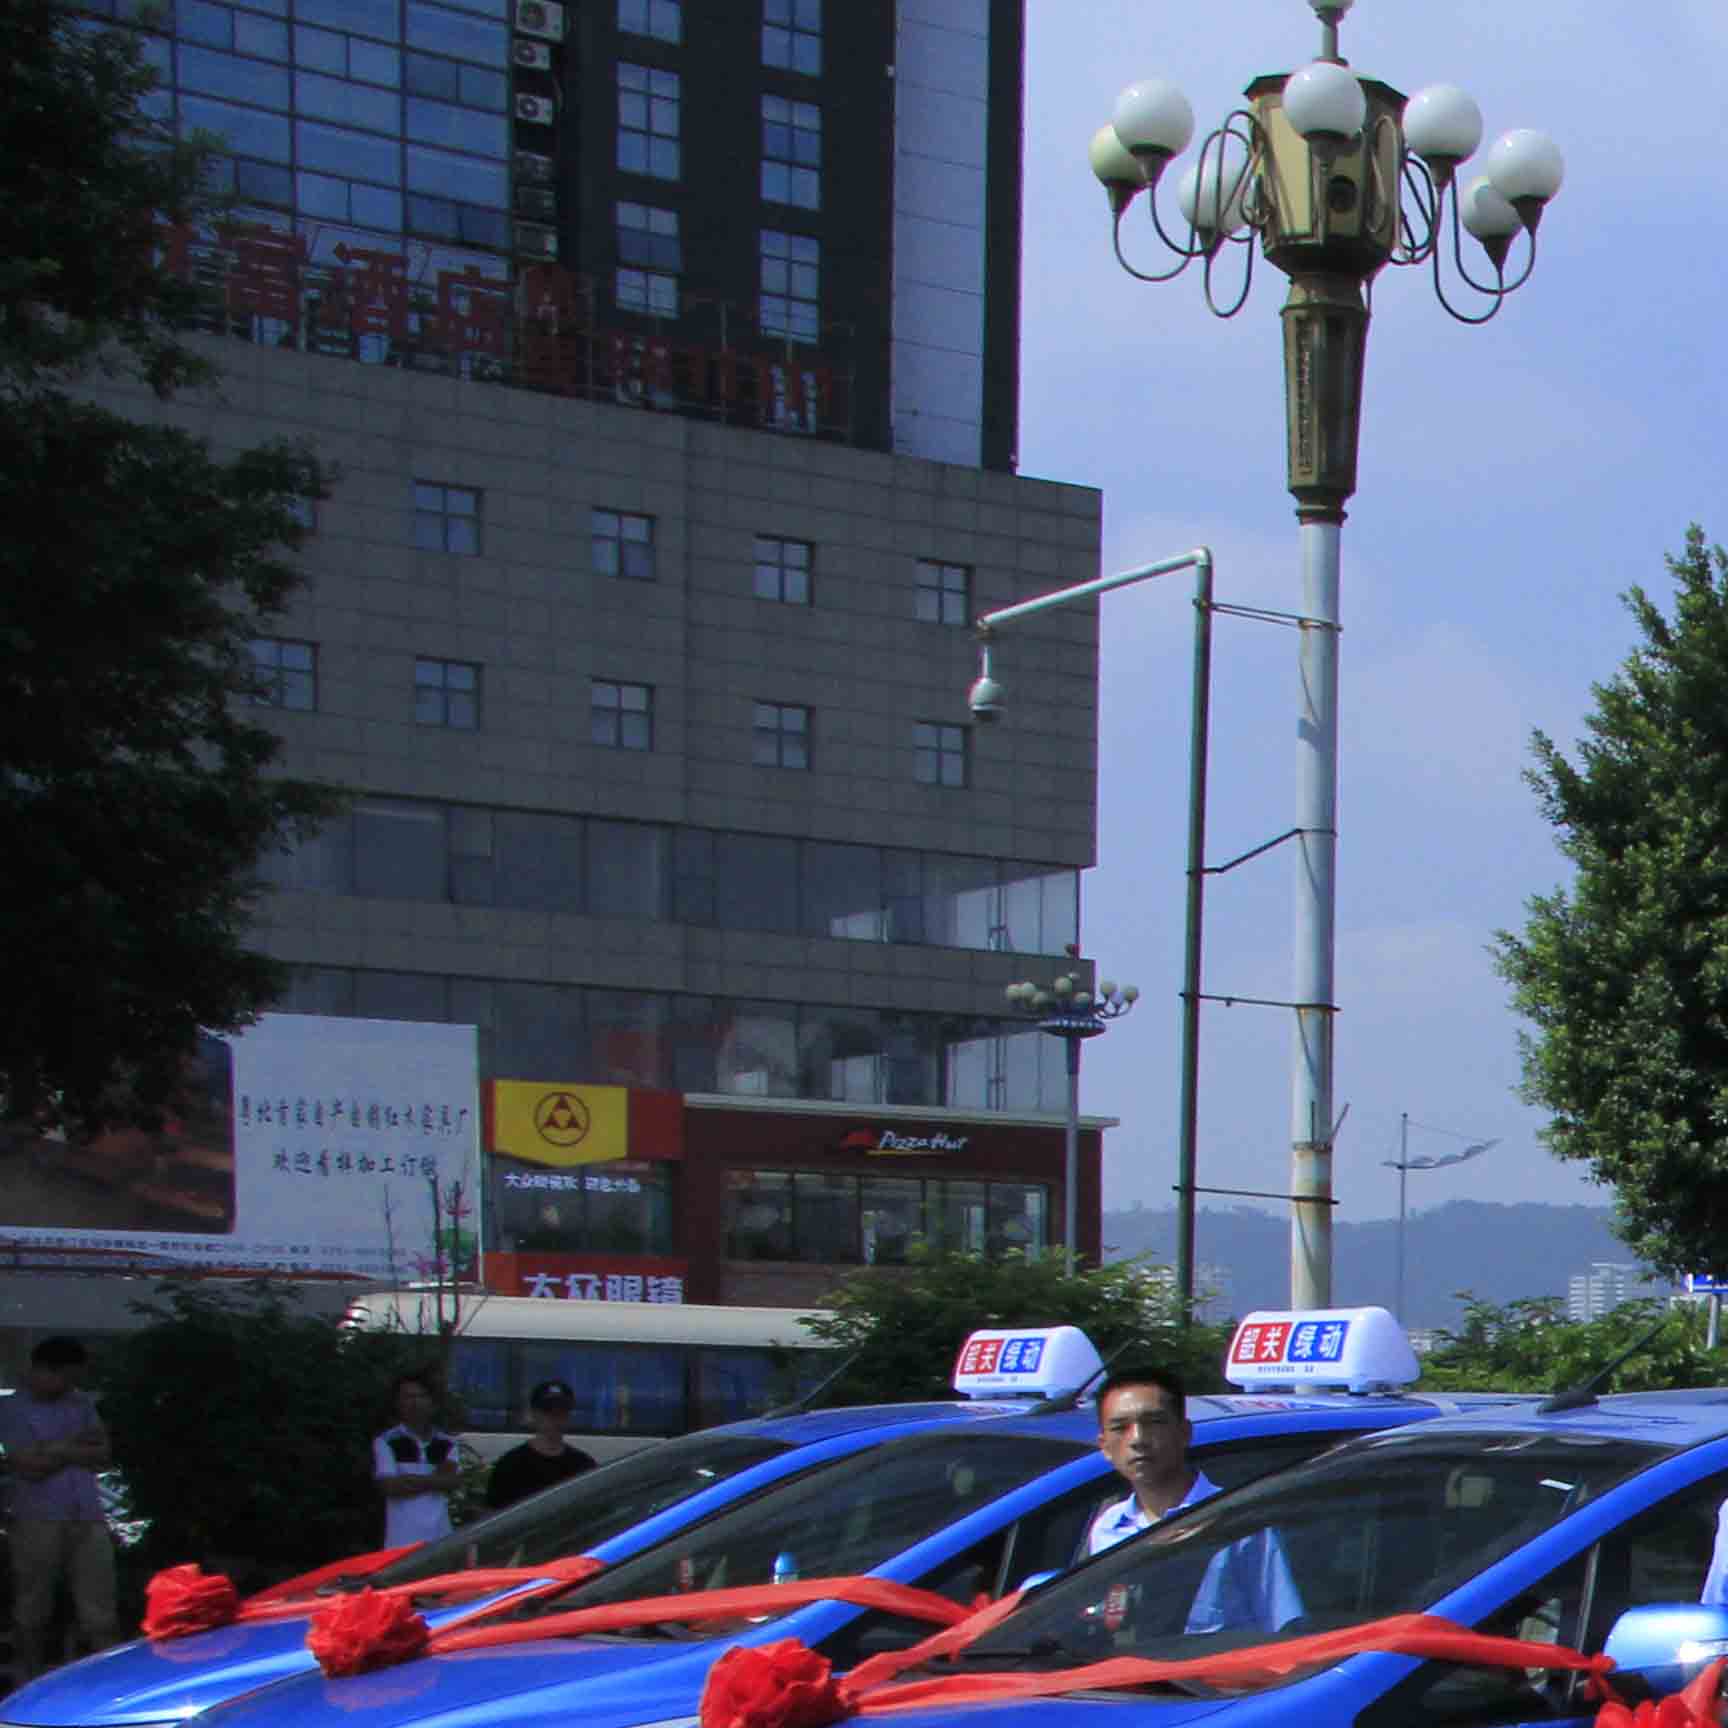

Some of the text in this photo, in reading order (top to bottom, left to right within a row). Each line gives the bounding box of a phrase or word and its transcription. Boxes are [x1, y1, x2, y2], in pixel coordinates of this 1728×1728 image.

[880, 1129, 968, 1152] Pizza Hut
[523, 1273, 682, 1303] 大众眼镜
